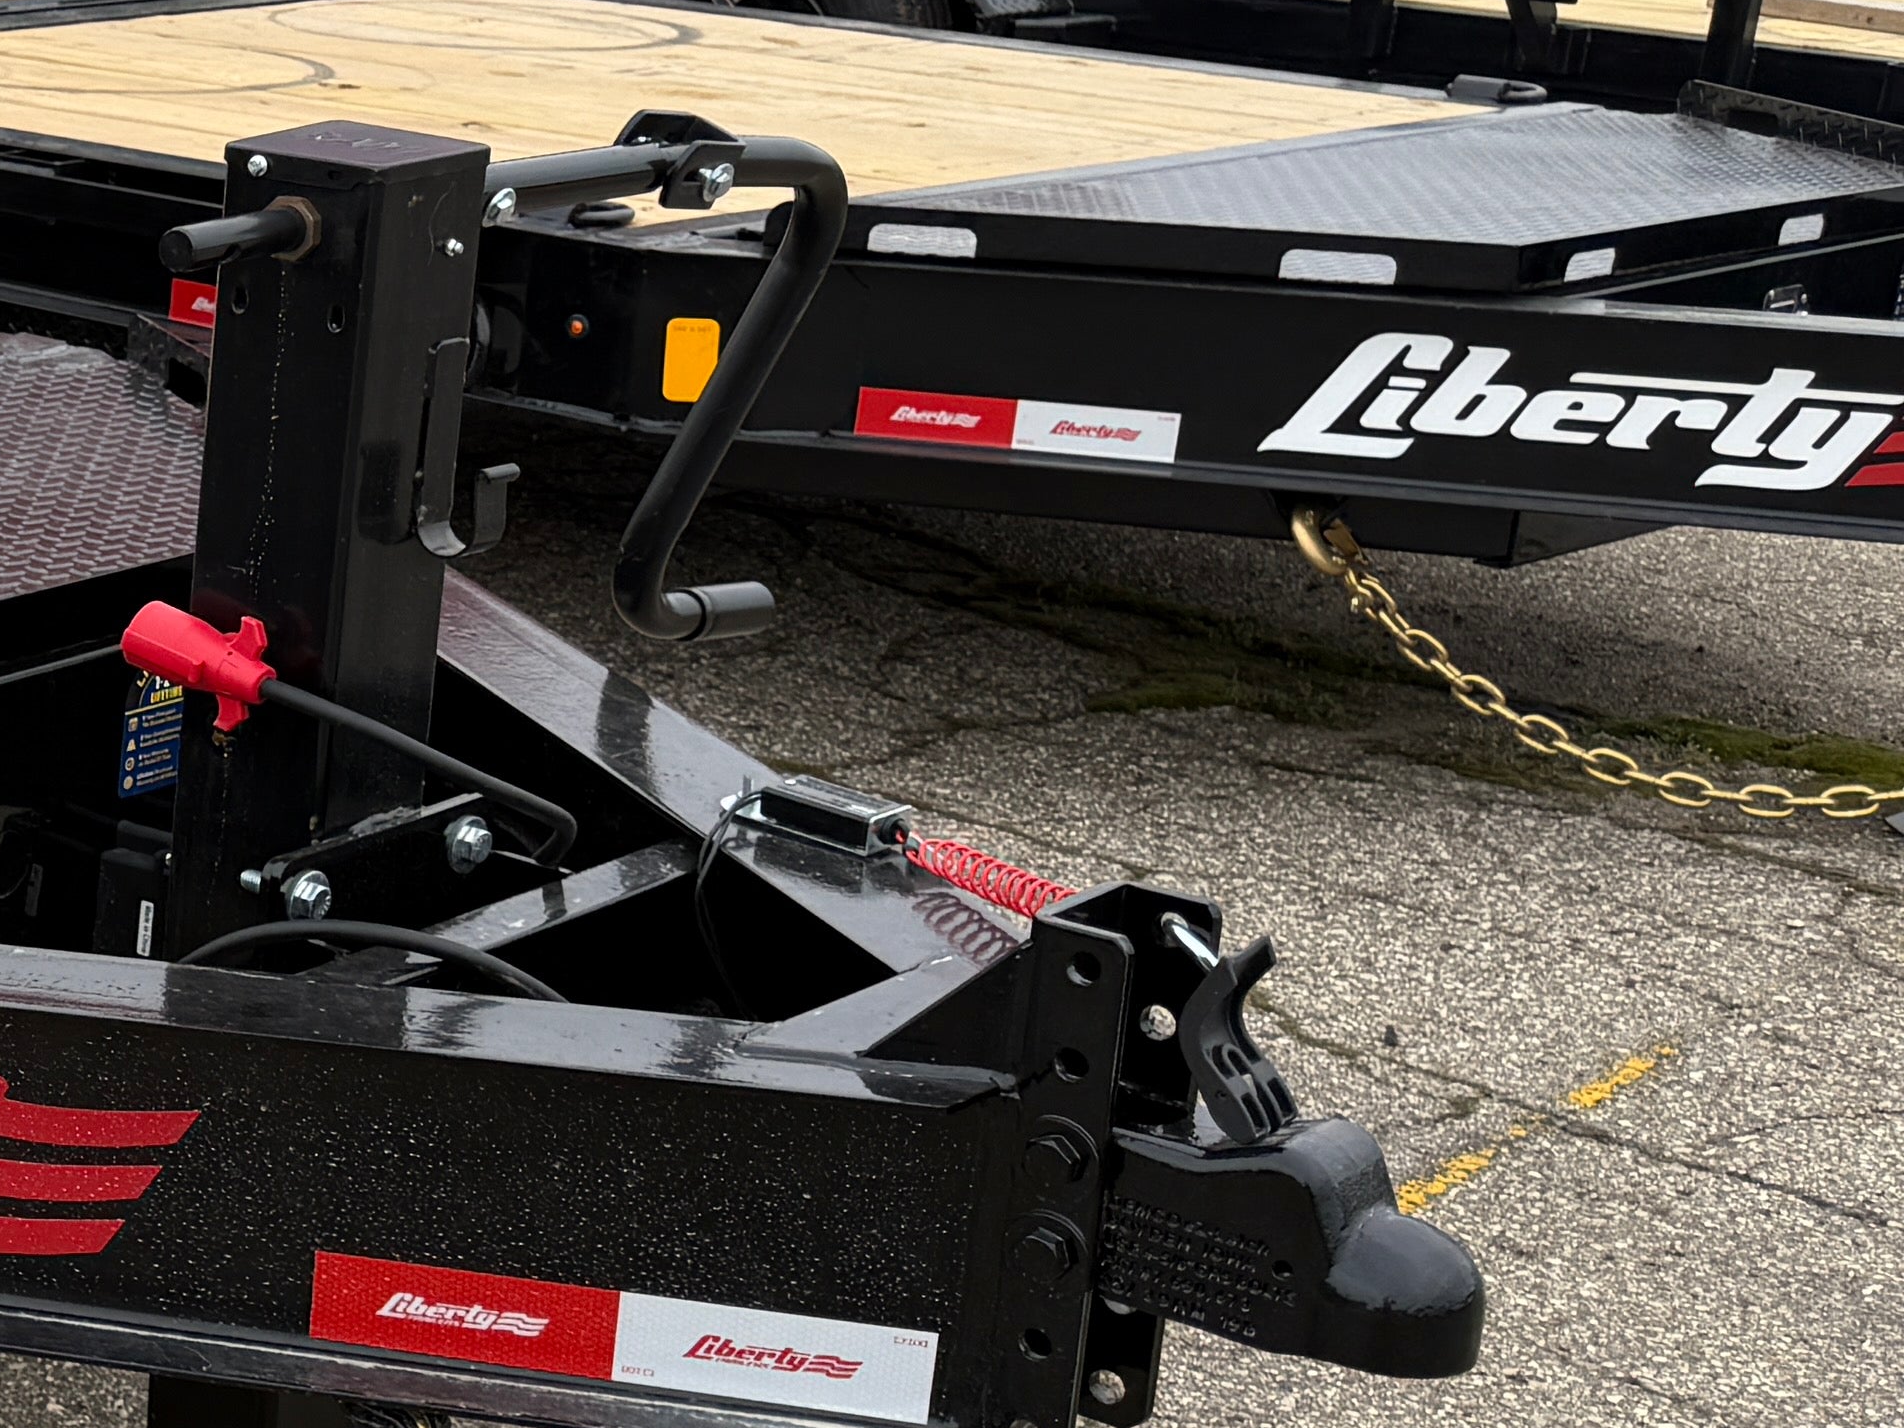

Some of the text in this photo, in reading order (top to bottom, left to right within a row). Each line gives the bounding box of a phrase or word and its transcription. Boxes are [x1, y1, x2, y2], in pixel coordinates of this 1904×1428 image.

[1257, 332, 1903, 491] Liberty
[375, 1292, 499, 1331] Liberty
[682, 1334, 811, 1372] Liberty
